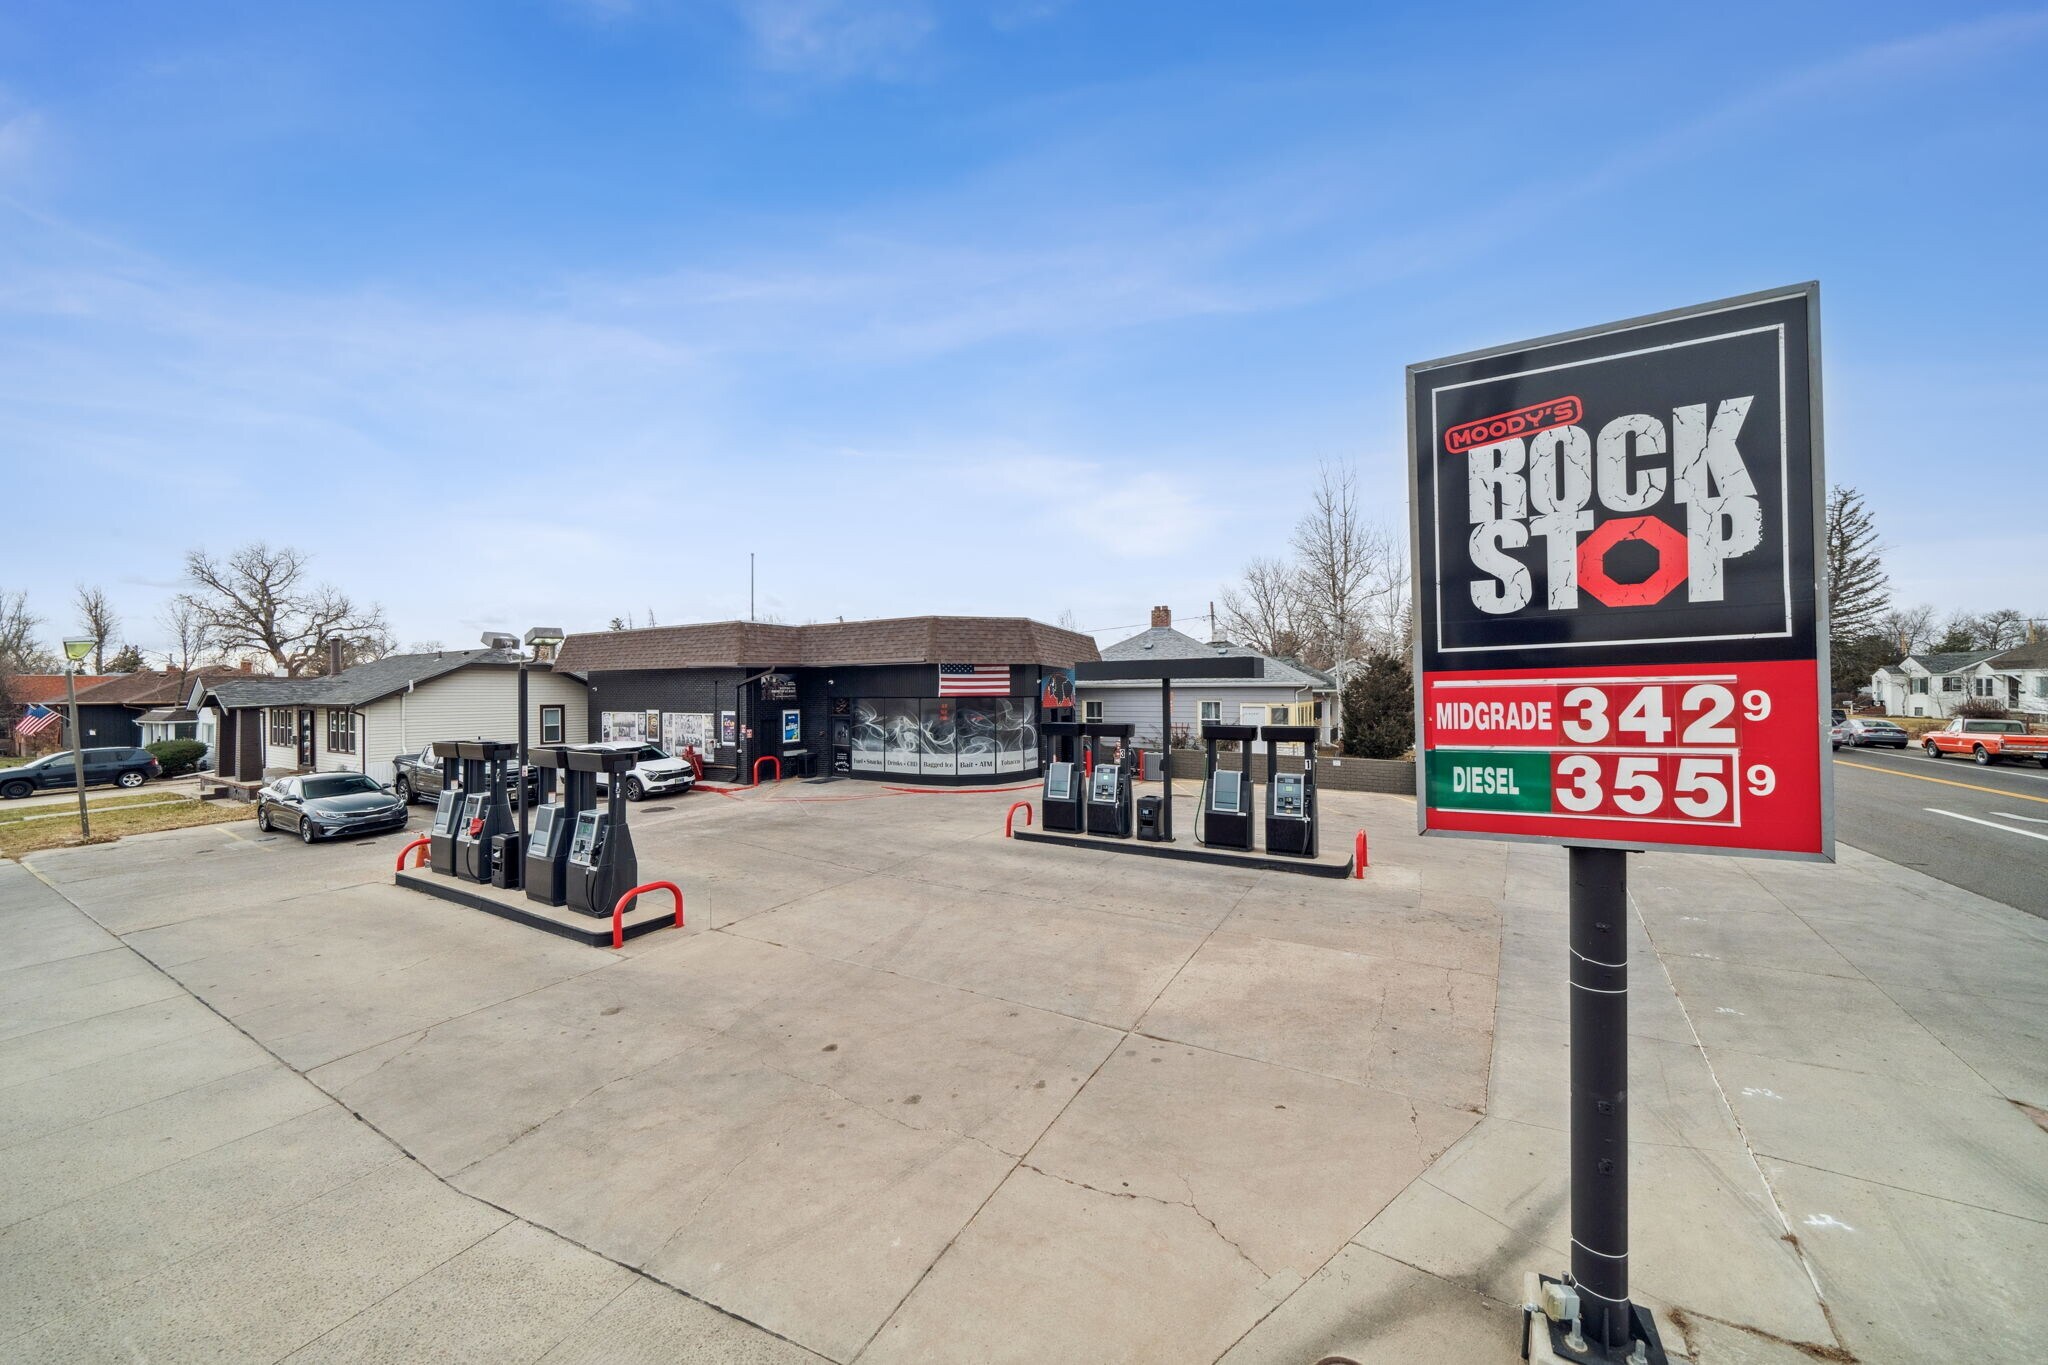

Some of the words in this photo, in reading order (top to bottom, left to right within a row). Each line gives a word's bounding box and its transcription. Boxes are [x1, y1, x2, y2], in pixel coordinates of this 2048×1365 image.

[1453, 401, 1574, 448] MOODY'S
[1468, 395, 1758, 523] ROCK
[1469, 495, 1763, 614] STOP
[1436, 701, 1552, 731] MIDGRADE
[1562, 684, 1736, 743] 342
[1742, 689, 1772, 721] 9
[923, 761, 943, 769] Bagged
[1453, 766, 1520, 795] DIESEL
[1555, 755, 1728, 818] 355
[1746, 764, 1776, 796] 9
